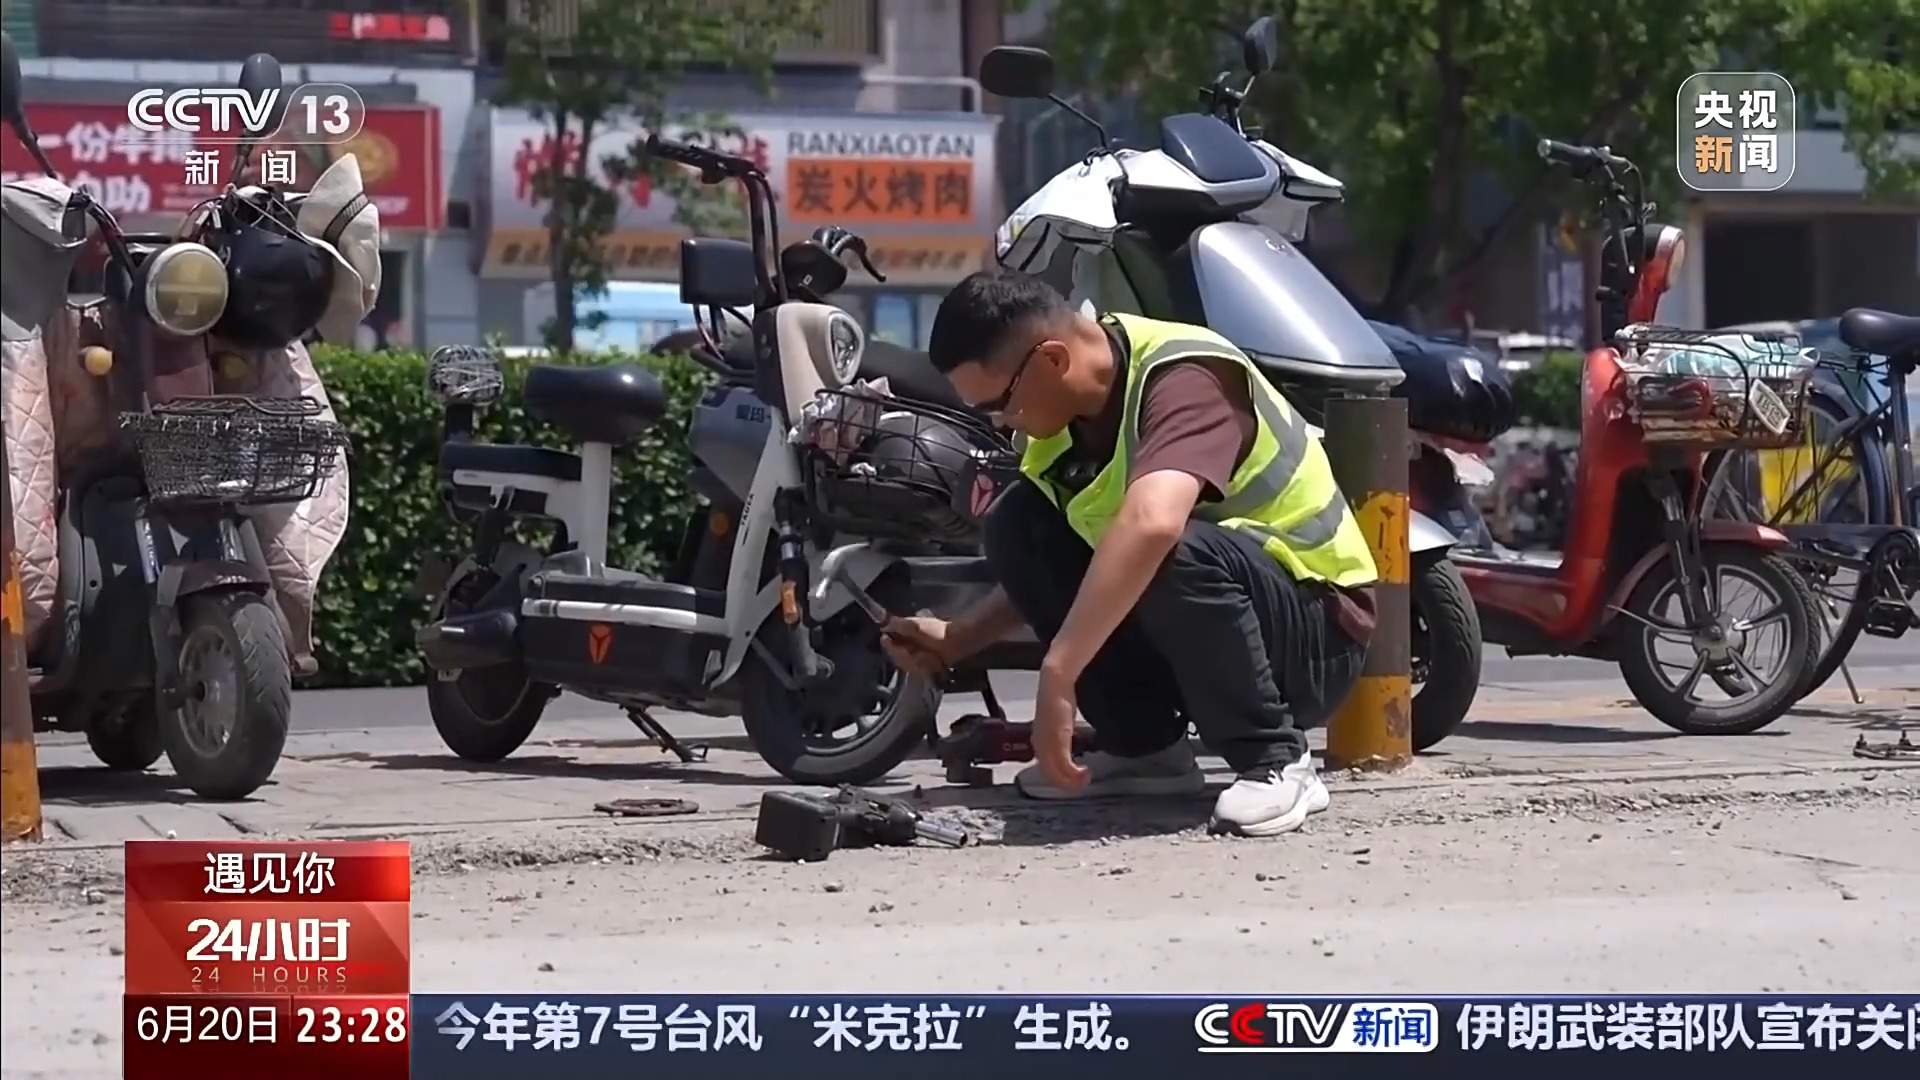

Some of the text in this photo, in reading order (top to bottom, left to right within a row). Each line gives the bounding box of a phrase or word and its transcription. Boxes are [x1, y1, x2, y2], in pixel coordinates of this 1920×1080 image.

[787, 131, 975, 157] RANXIAOTAN
[794, 163, 972, 216] 炭火烤肉
